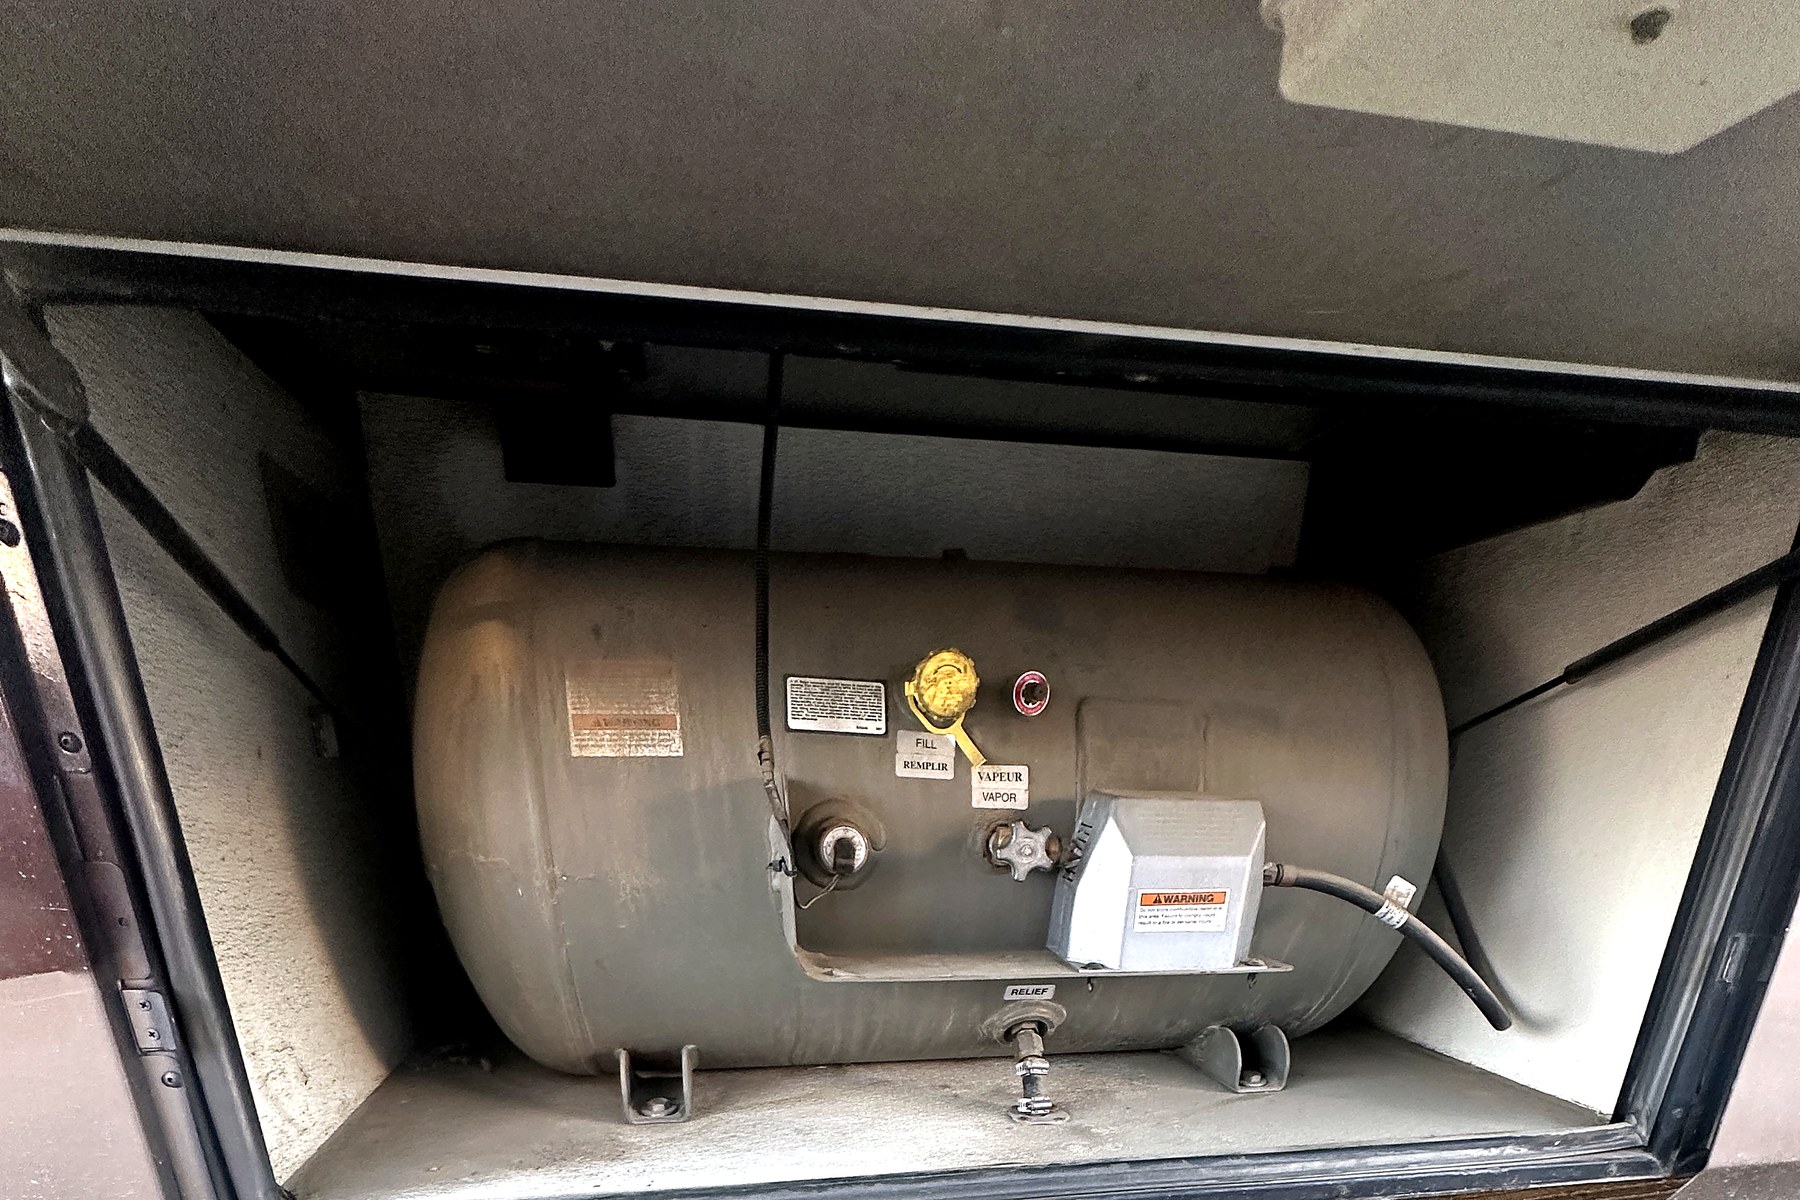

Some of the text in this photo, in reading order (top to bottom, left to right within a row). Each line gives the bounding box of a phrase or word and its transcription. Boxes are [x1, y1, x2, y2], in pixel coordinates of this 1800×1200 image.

[915, 738, 937, 750] FILL
[903, 760, 949, 772] REMPLIR
[977, 771, 1023, 782] VAPEUR
[982, 792, 1017, 803] VAPOR
[1163, 894, 1214, 904] WARNING
[1010, 987, 1049, 996] RELIEF
